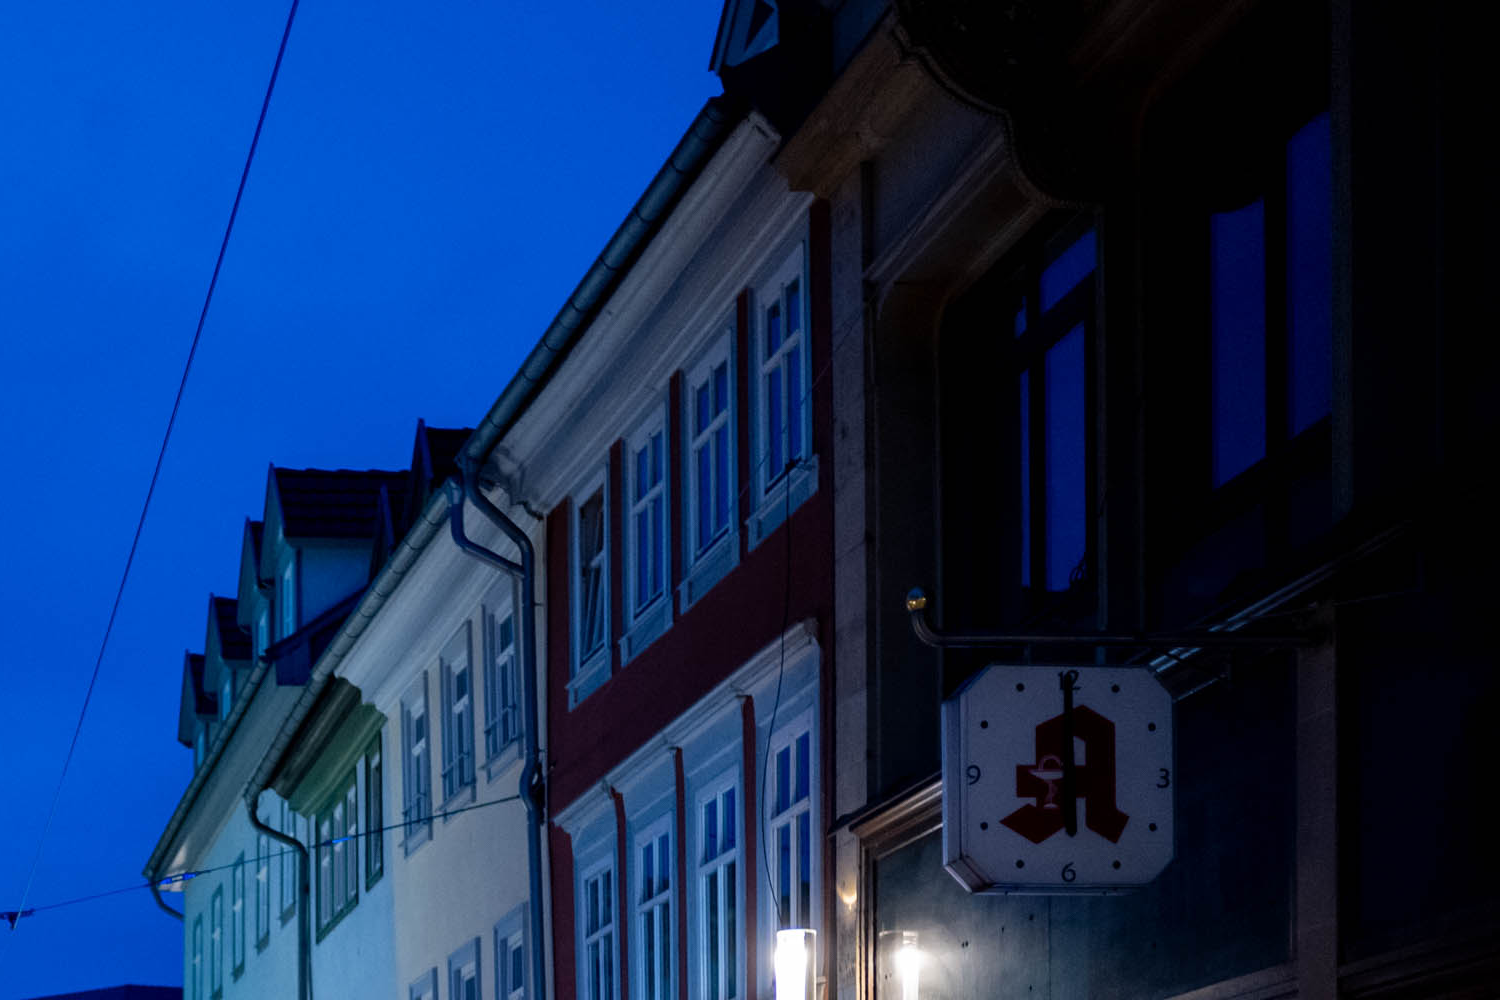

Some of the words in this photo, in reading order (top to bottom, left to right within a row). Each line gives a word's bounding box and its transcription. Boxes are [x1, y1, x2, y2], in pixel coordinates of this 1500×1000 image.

[966, 764, 981, 786] 9
[1157, 768, 1170, 789] 3
[1062, 862, 1076, 883] 6
